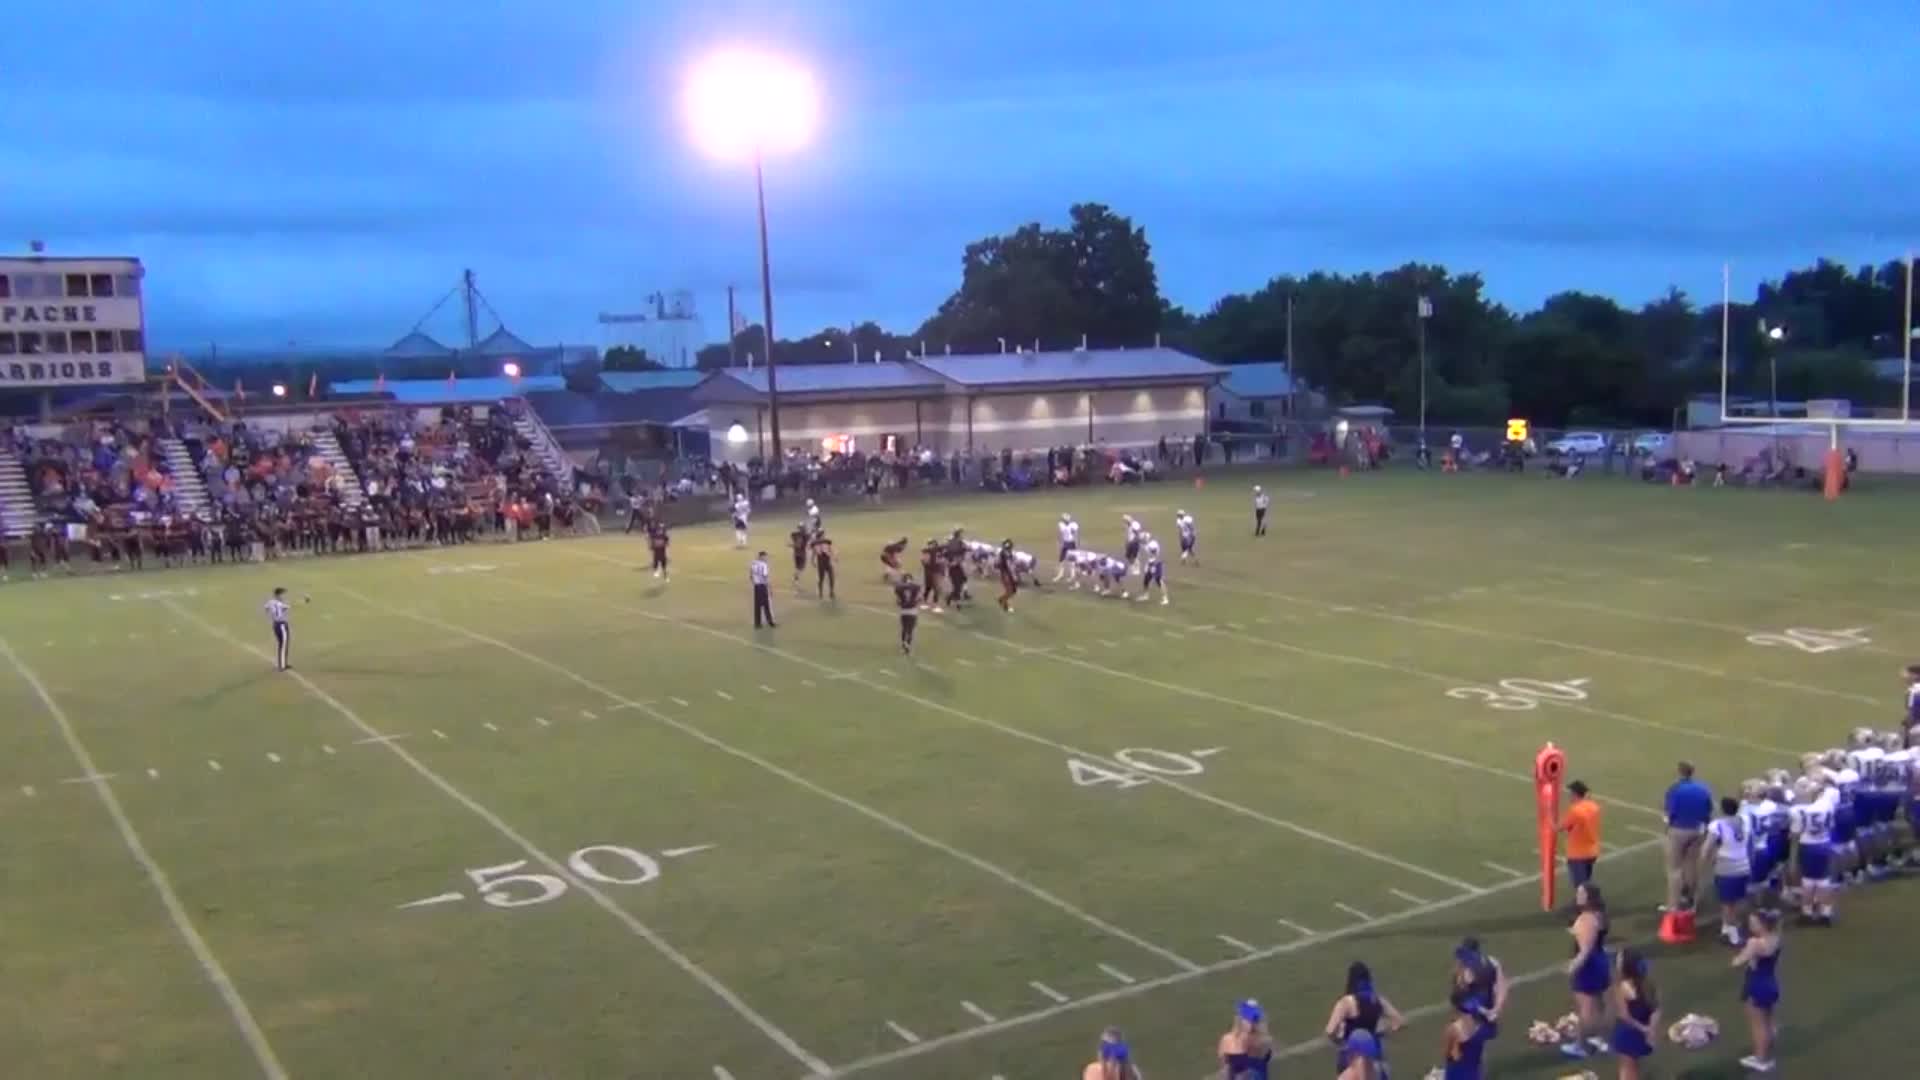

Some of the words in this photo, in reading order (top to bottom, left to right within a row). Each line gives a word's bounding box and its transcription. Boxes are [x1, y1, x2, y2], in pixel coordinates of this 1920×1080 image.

[3, 305, 97, 322] PACHE
[1067, 748, 1203, 789] 40
[466, 844, 661, 908] 50
